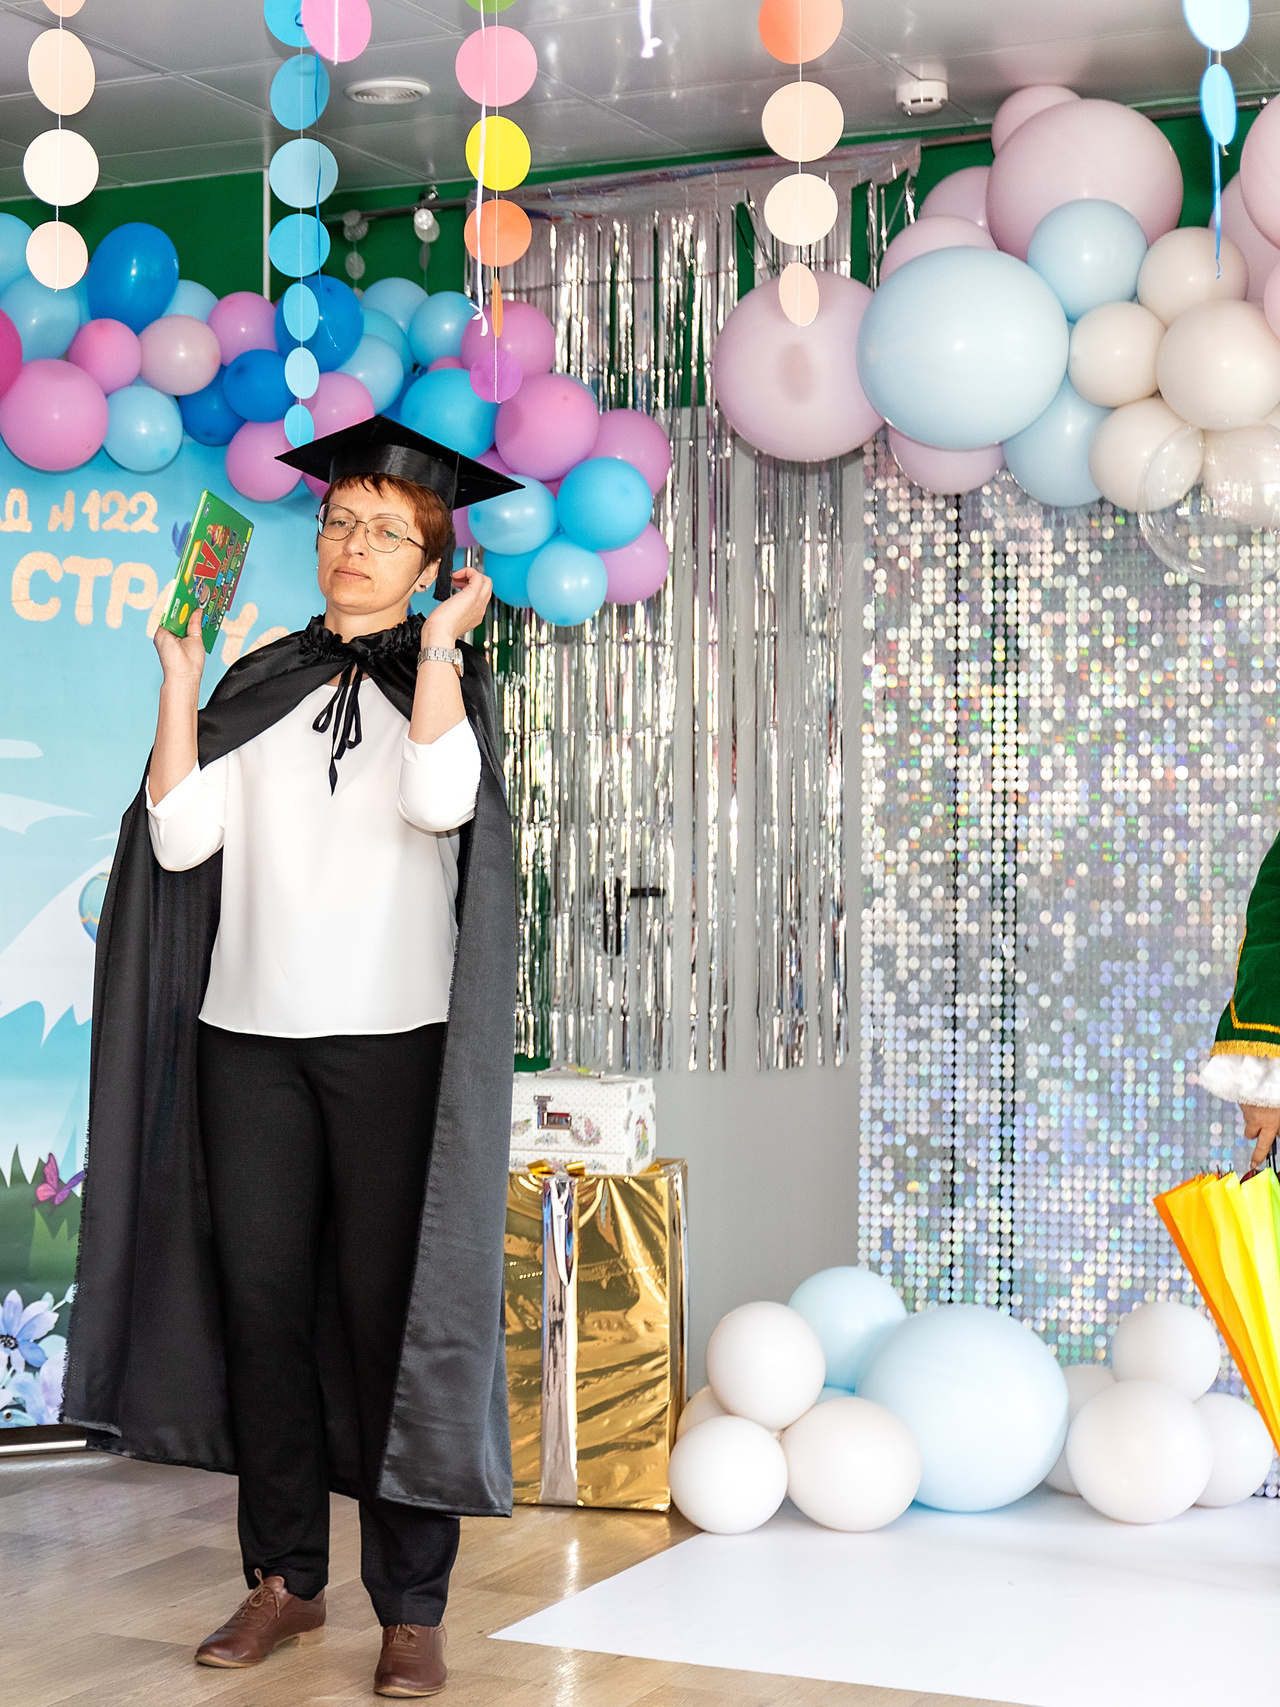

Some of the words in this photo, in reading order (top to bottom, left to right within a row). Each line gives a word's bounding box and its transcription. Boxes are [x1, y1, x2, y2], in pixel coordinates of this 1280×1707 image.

[201, 530, 238, 628] БУКВАРЬ
[210, 541, 242, 626] АЗБУКА
[214, 576, 236, 632] ЖУКОВА
